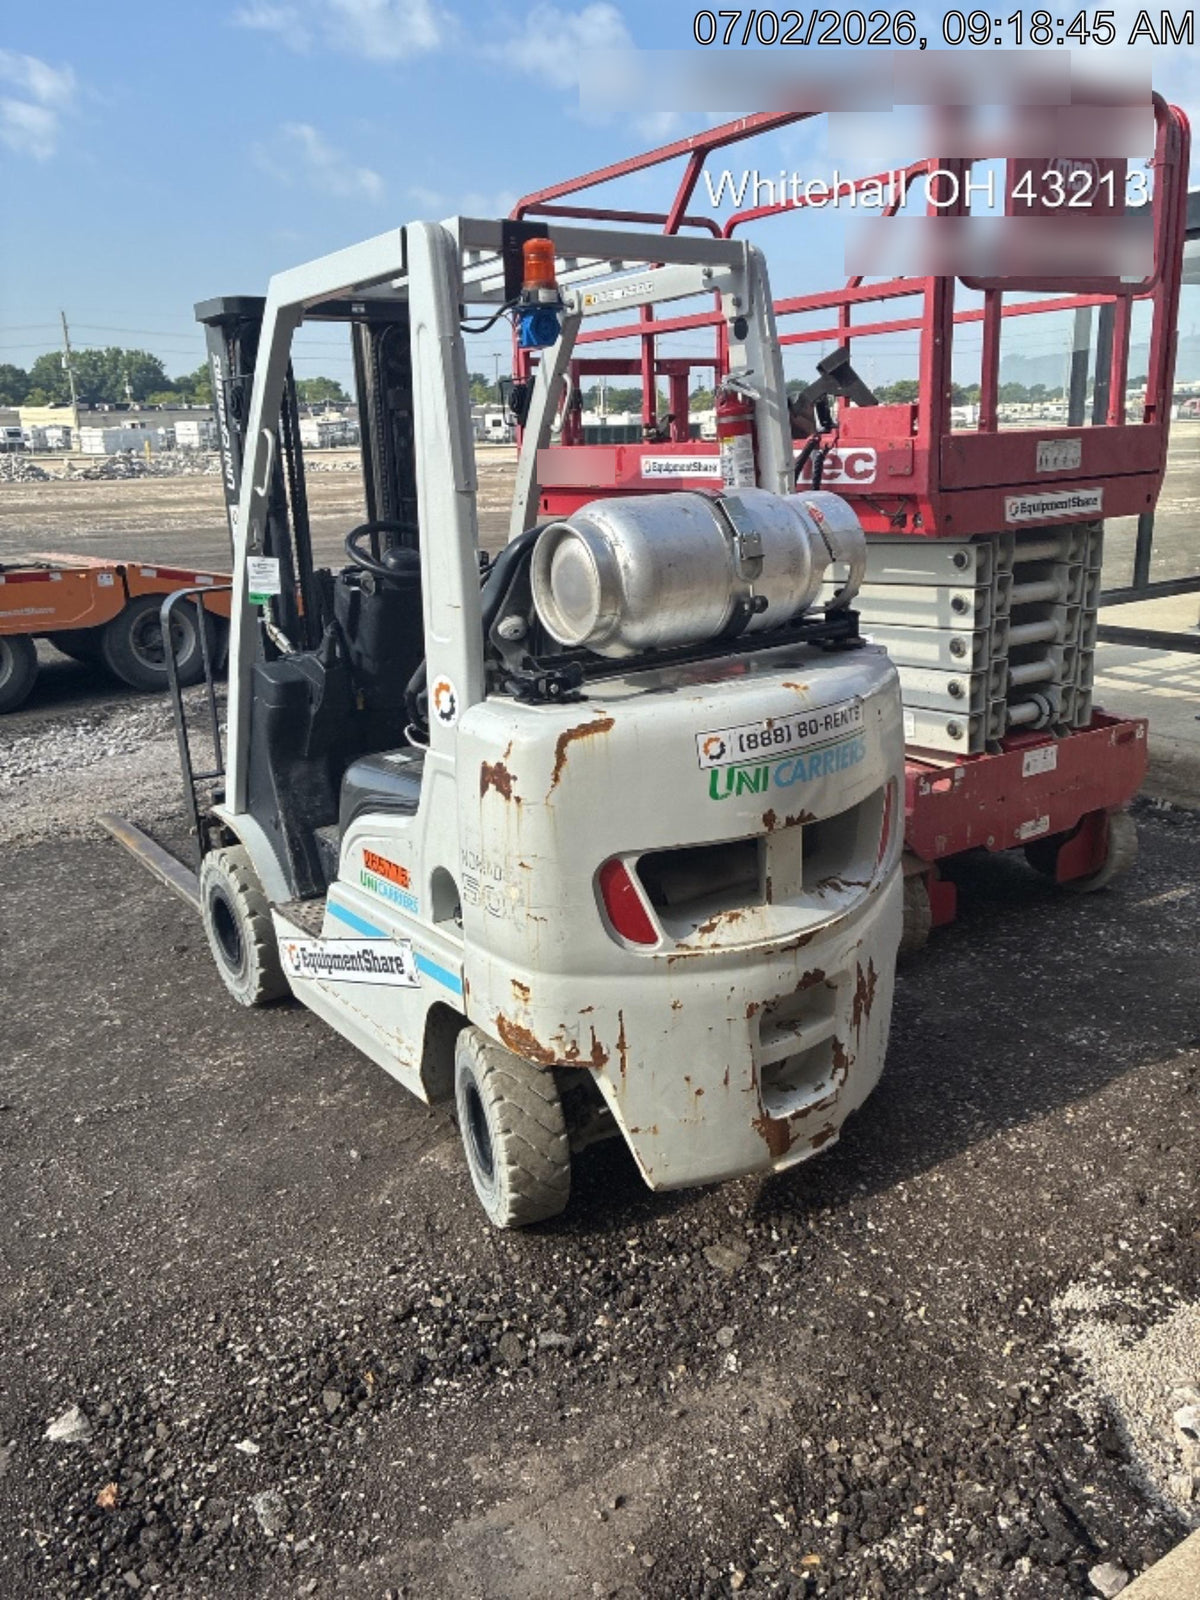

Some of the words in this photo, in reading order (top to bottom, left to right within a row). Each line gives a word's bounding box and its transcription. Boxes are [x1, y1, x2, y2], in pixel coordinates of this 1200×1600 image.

[652, 461, 718, 474] EquipmentShare
[1020, 496, 1098, 516] EquipmentShare
[738, 724, 792, 753] (888)
[299, 946, 405, 976] EquipmentShare
